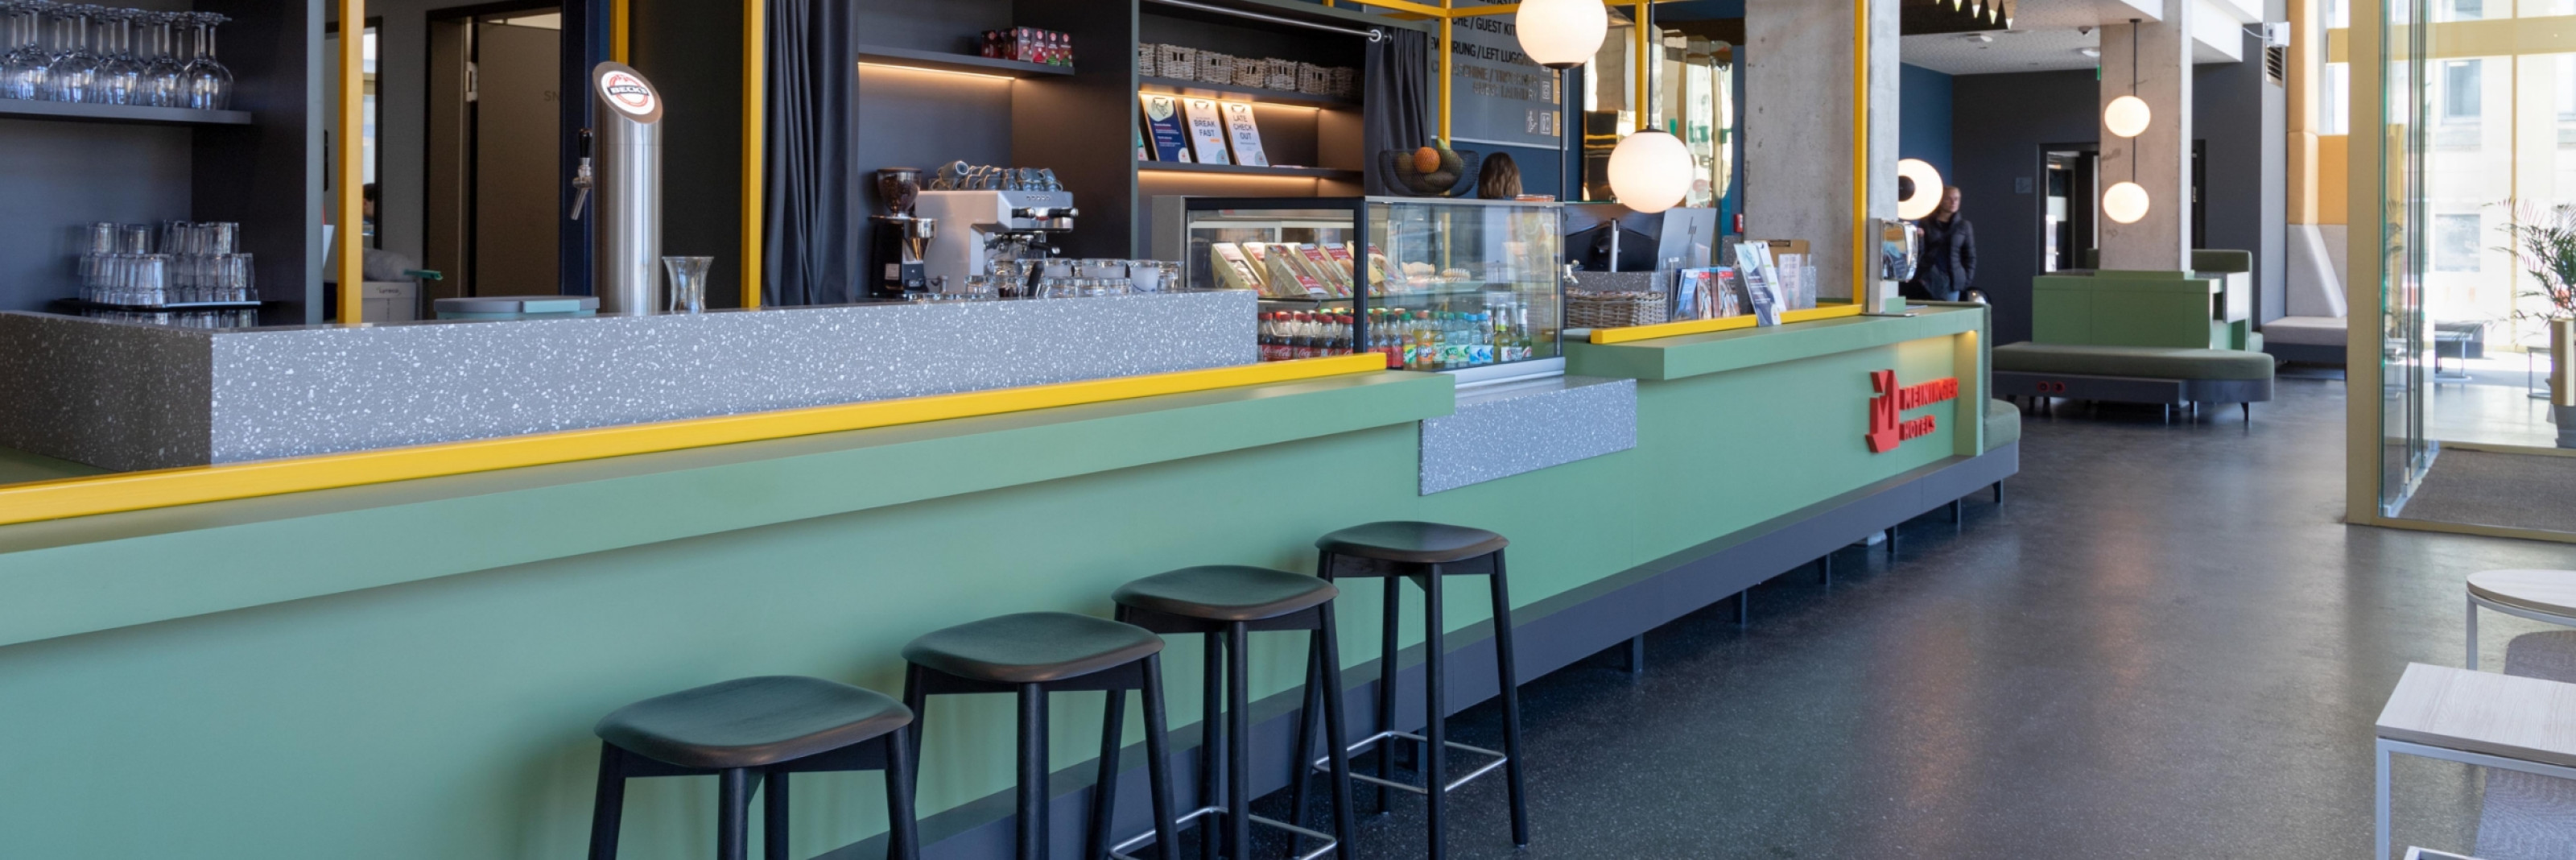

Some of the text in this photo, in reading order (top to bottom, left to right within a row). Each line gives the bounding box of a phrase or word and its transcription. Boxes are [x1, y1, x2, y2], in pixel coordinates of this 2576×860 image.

[1476, 18, 1502, 33] GUEST
[1482, 47, 1500, 60] LEFT
[1194, 119, 1216, 127] BREAK
[1233, 114, 1248, 122] LATE
[1900, 376, 1959, 411] MEININGER
[1900, 415, 1935, 440] HOTELS
